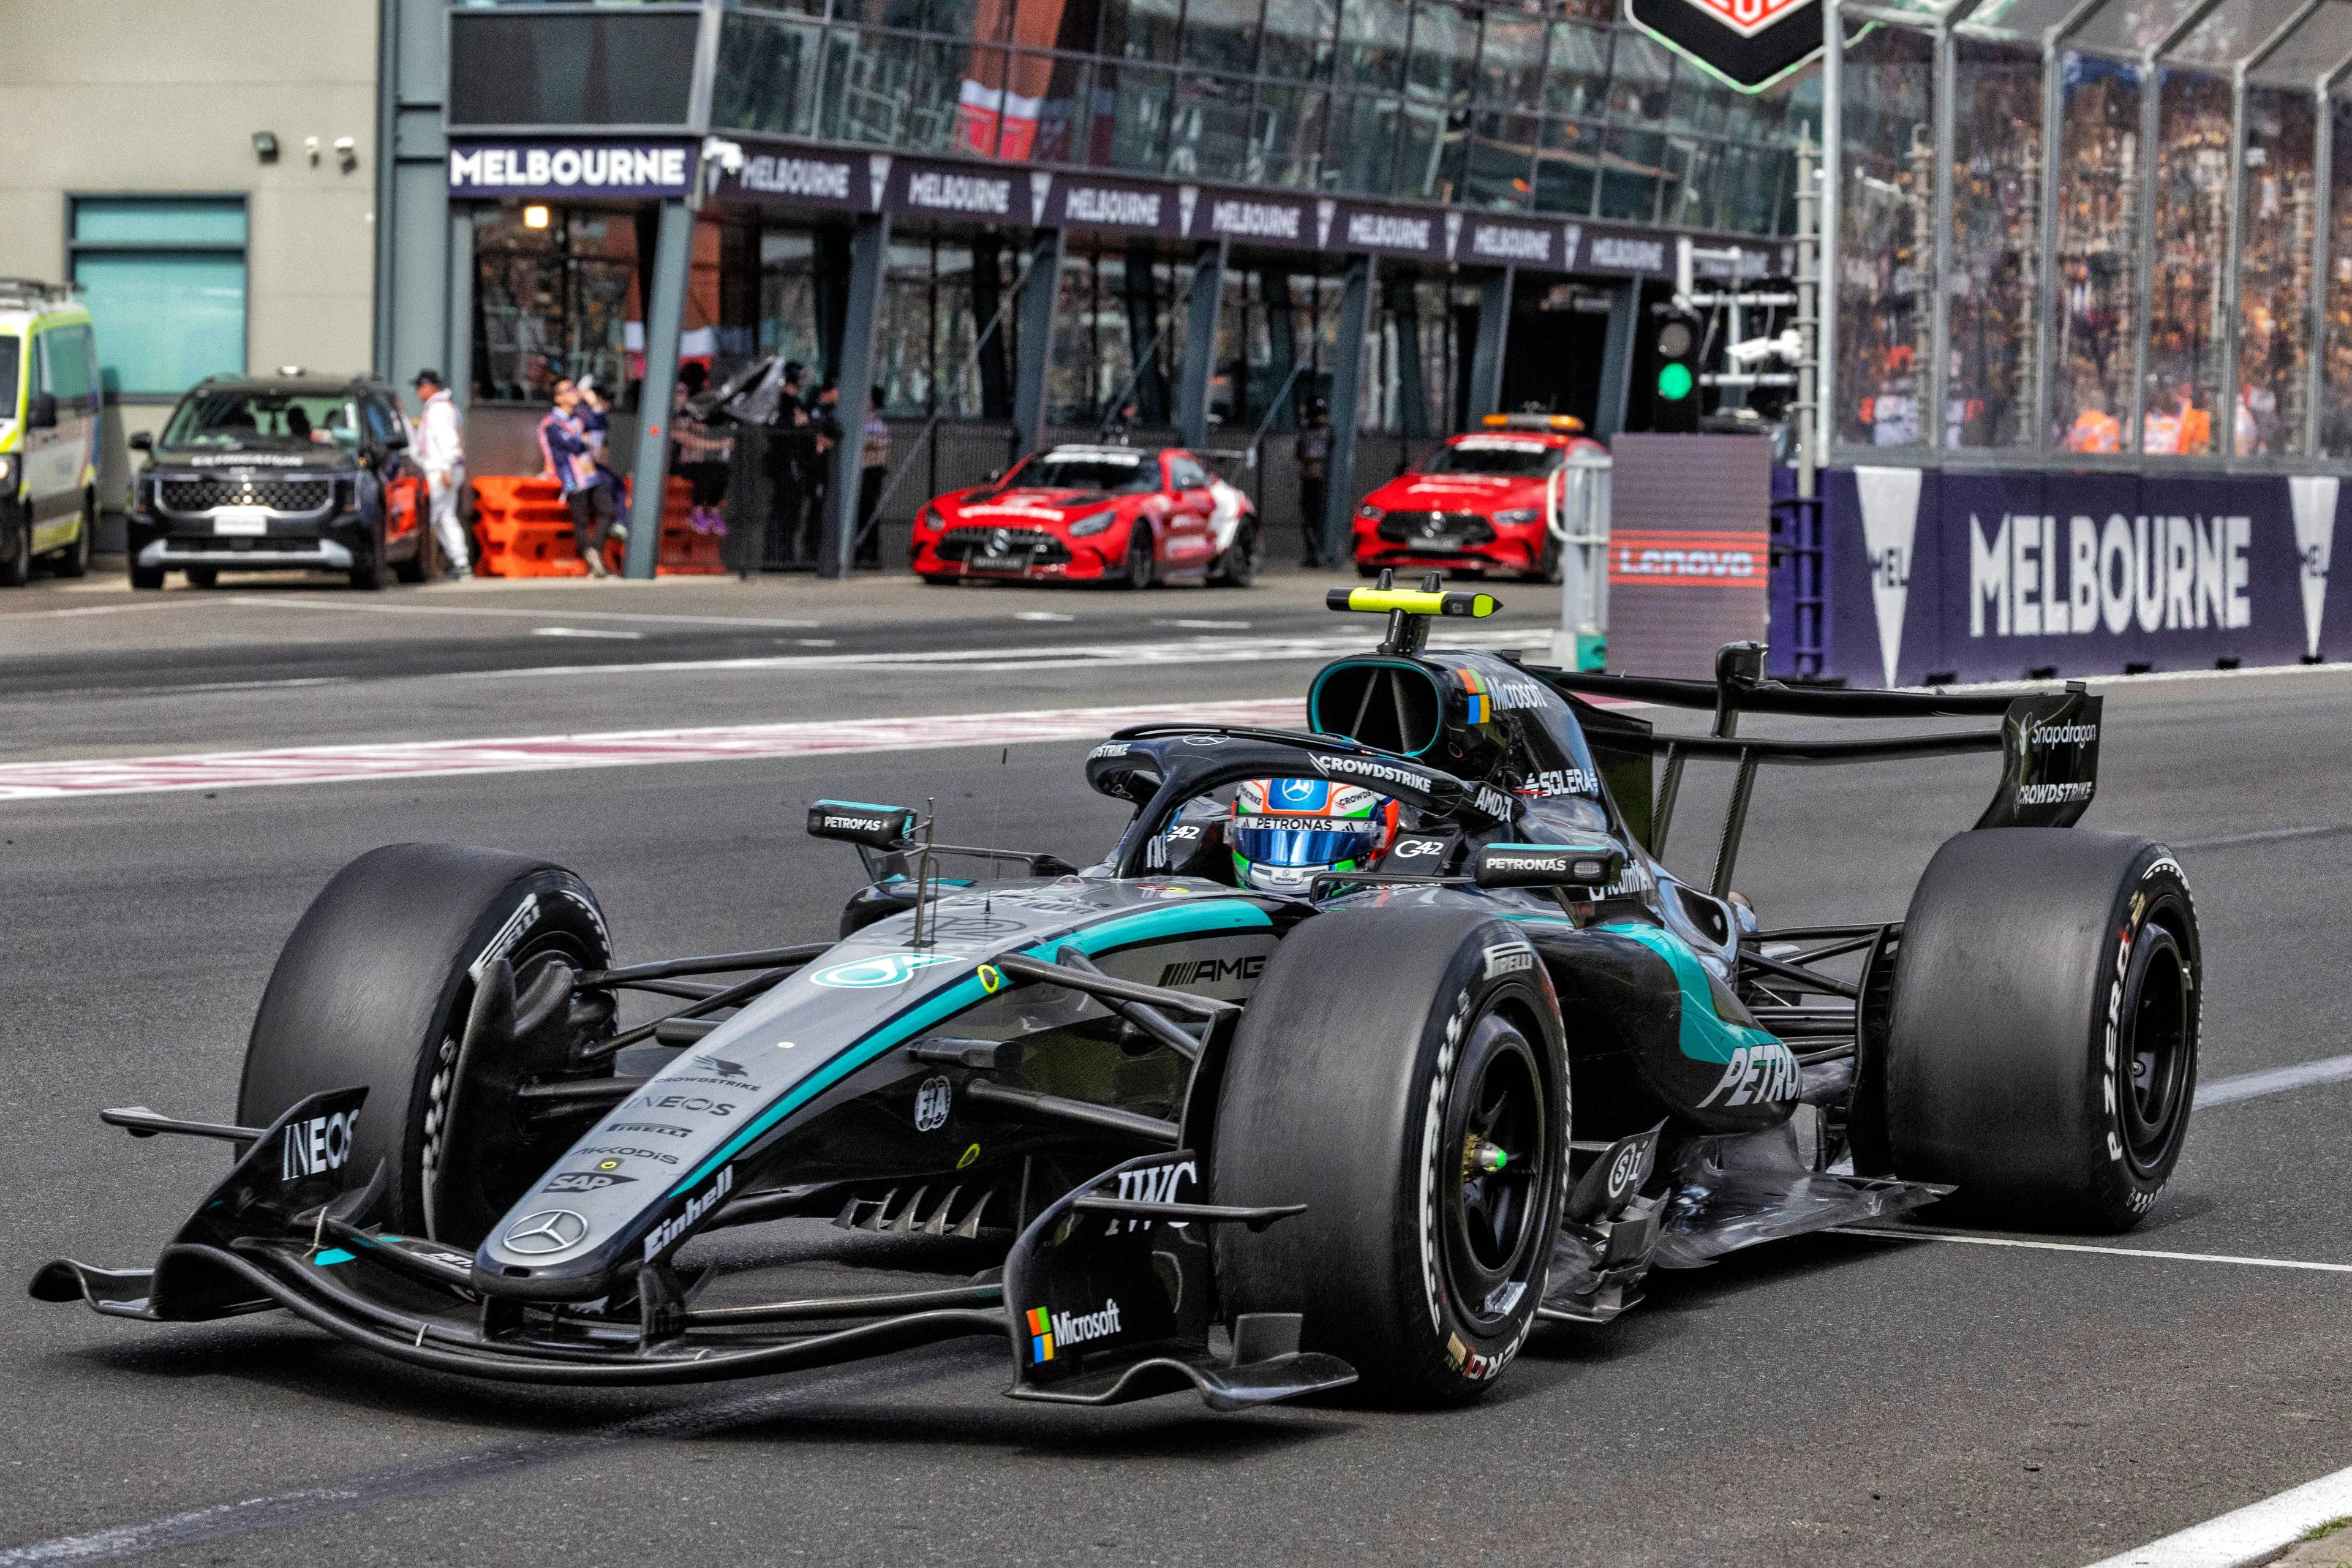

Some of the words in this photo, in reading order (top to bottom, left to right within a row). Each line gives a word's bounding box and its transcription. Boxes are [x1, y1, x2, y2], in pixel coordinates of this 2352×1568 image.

[451, 149, 685, 186] MELBOURNE
[741, 154, 850, 198] MELBOURNE
[908, 172, 1011, 214] MELBOURNE
[1066, 187, 1161, 227] MELBOURNE
[1212, 200, 1300, 238] MELBOURNE
[1348, 213, 1431, 250] MELBOURNE
[1619, 549, 1752, 576] Lenovo
[1970, 512, 2251, 636] MELBOURNE
[1486, 676, 1547, 710] Microsoft
[2032, 719, 2096, 750] Snapdragon
[1320, 756, 1431, 793] CROWDSTRIKE
[1539, 769, 1593, 796] SOLERA
[1474, 787, 1506, 821] AMD
[824, 816, 881, 831] PETRONAS
[1257, 818, 1332, 831] PETRONAS
[1395, 840, 1444, 858] G42
[1487, 858, 1566, 871] PETRONAS
[655, 1077, 761, 1092] CROWDSTRIKE
[622, 1096, 737, 1116] INEOS
[606, 1123, 693, 1137] PIRELLI
[552, 1175, 614, 1190] SAP
[644, 1164, 733, 1263] Einhell
[1052, 1298, 1121, 1347] Microsoft
